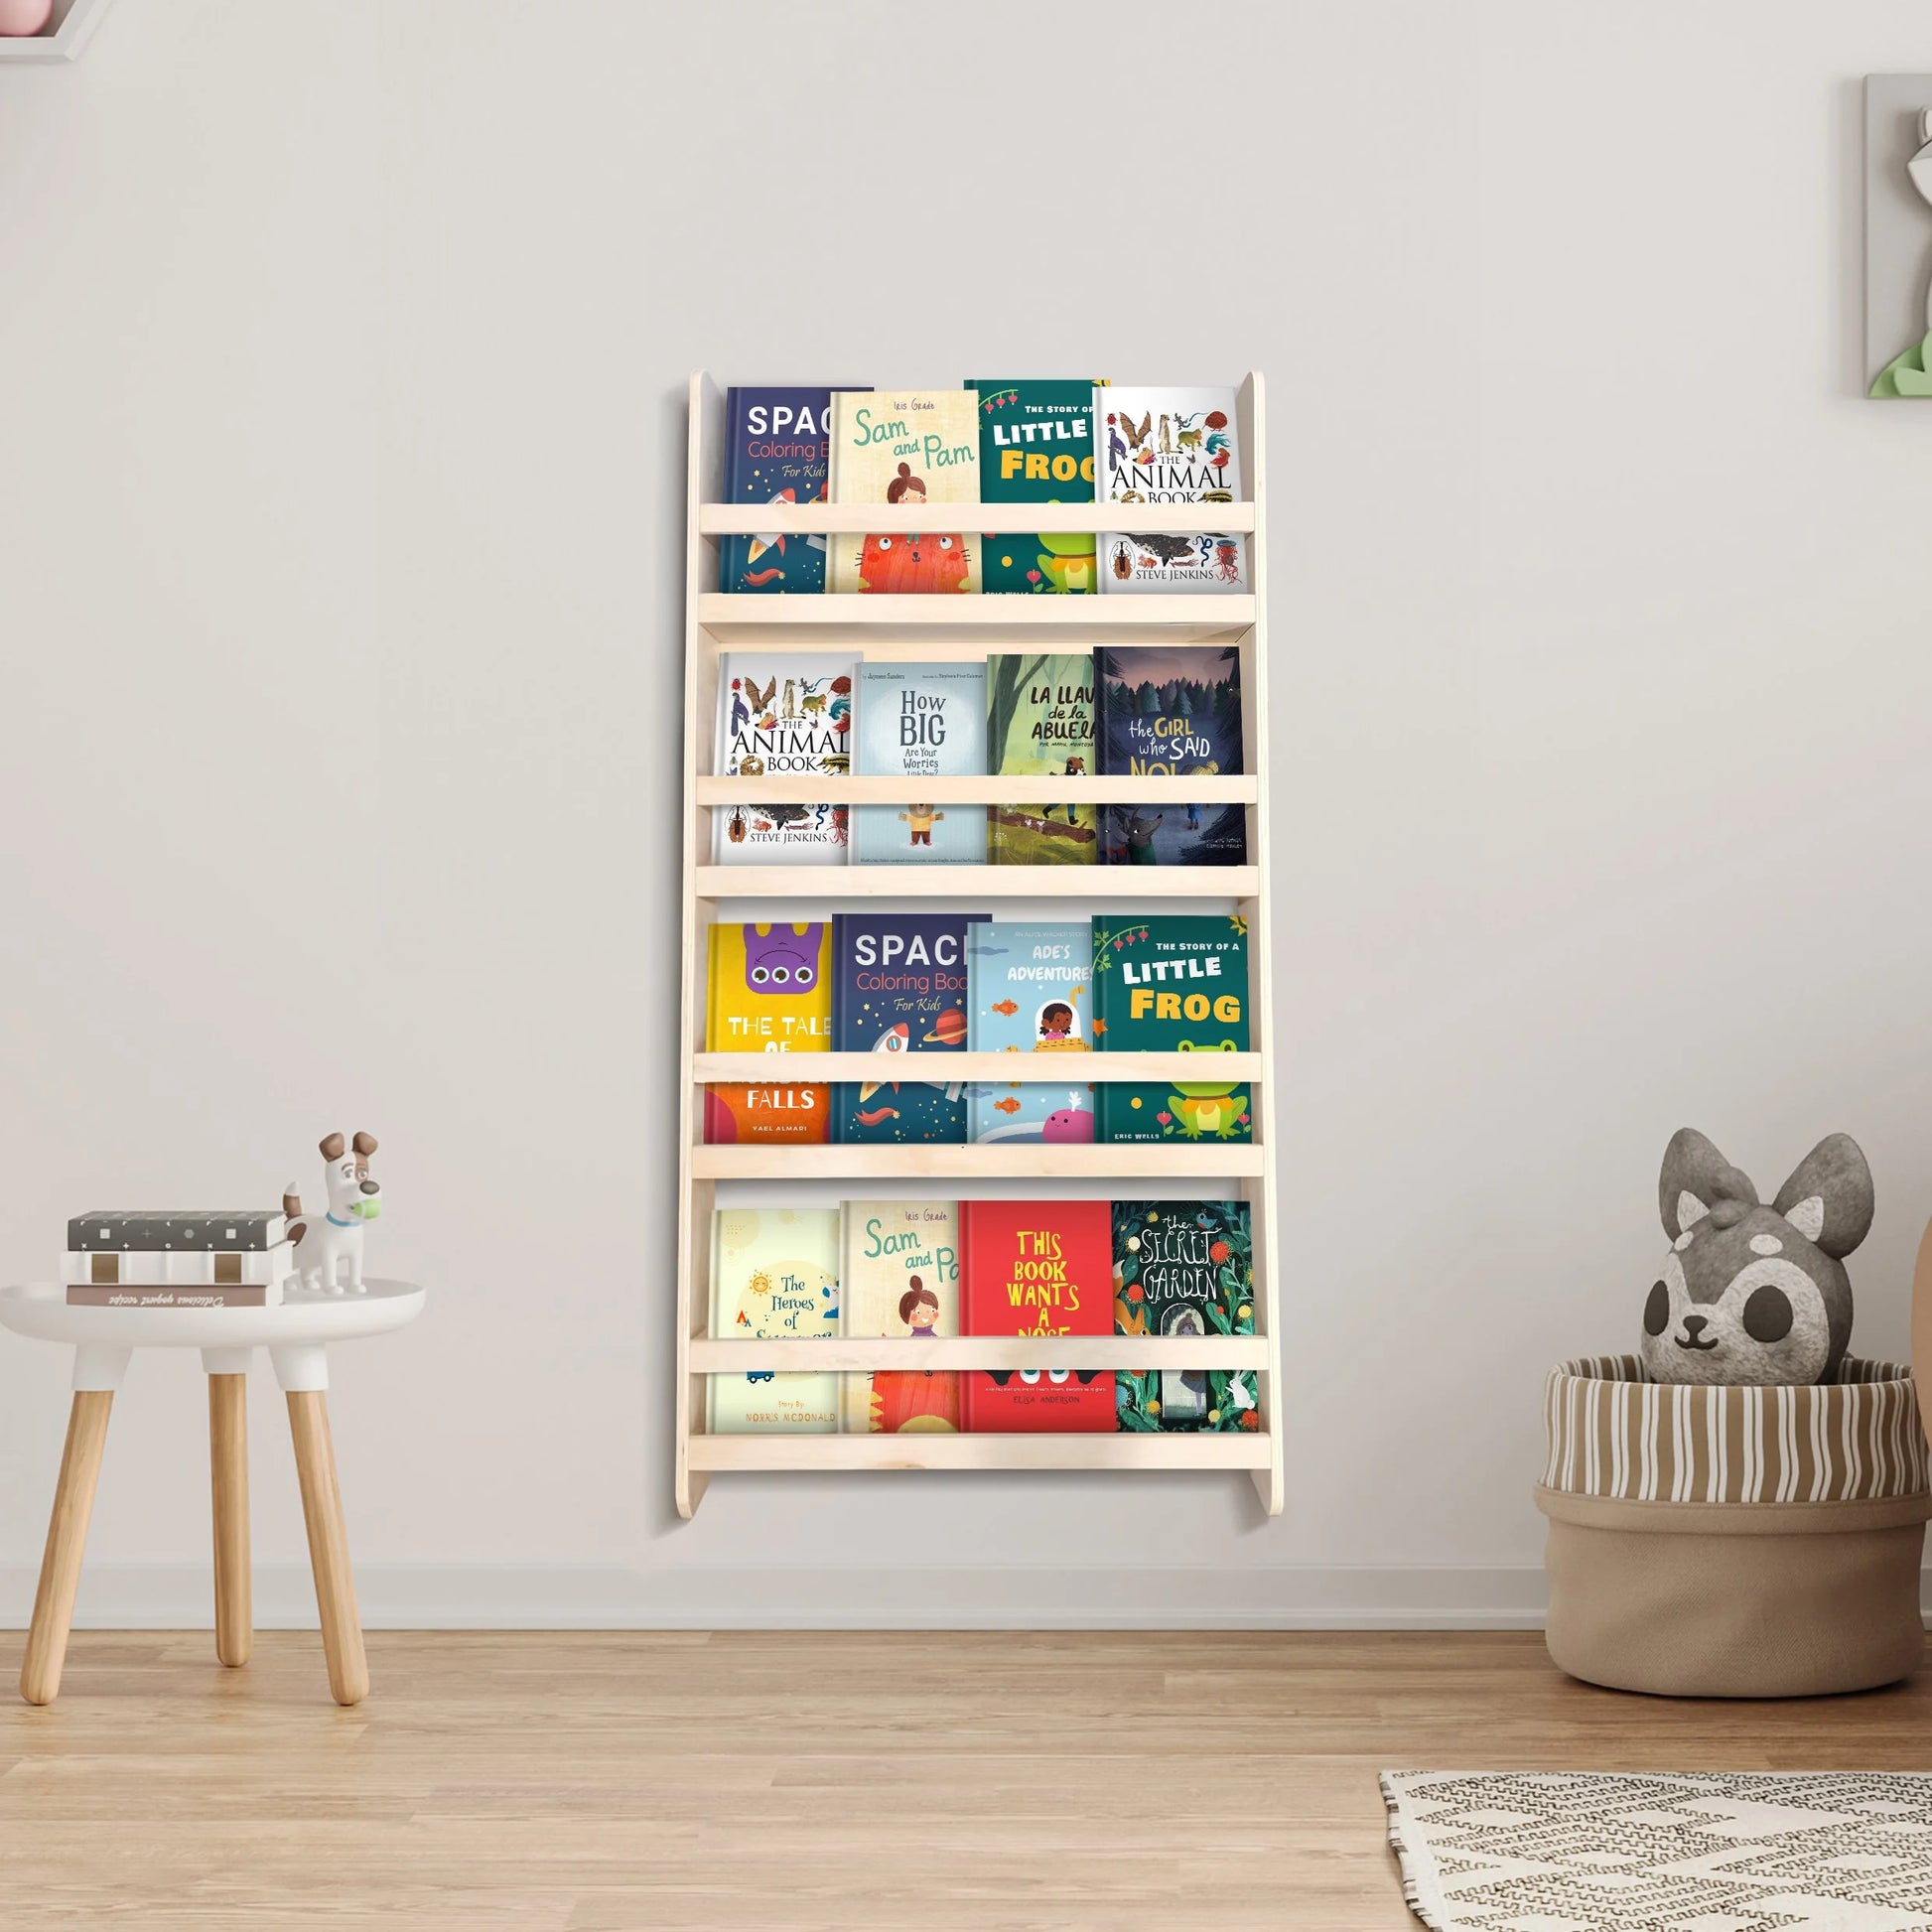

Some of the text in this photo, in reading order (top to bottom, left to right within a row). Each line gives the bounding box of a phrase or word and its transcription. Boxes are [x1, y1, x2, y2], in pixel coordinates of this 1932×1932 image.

[894, 398, 935, 411] Iris Grade
[853, 408, 909, 447] Sam
[993, 419, 1087, 446] LITTLE
[748, 441, 816, 462] Coloring
[894, 439, 921, 457] and
[923, 435, 975, 470] Pam
[1160, 456, 1180, 465] THE
[781, 463, 827, 478] For Kids
[1111, 466, 1232, 489] ANIMAL
[1136, 570, 1214, 582] STEVE JENKINS
[901, 690, 946, 714] How
[1031, 686, 1049, 704] LA
[1047, 705, 1087, 719] de la
[782, 721, 803, 730] THE
[899, 713, 946, 747] BIG
[1128, 717, 1194, 738] the GIRL
[731, 730, 850, 755] ANIMAL
[1139, 737, 1210, 760] who SAID
[904, 748, 937, 758] Are Your
[767, 757, 818, 771] BOOK
[903, 759, 939, 768] Worries
[750, 833, 827, 844] STEVE JENKINS
[855, 935, 968, 966] SPAC
[1033, 945, 1070, 960] ADE'S
[1123, 957, 1222, 985] LITTLE
[856, 972, 929, 995] Coloring
[894, 996, 941, 1012] For Kids
[1130, 989, 1241, 1023] FROG
[728, 1017, 832, 1035] THE TALE
[747, 1090, 815, 1109] FALLS
[905, 1208, 948, 1221] Iris Grade
[1162, 1214, 1193, 1229] the
[864, 1218, 921, 1258] Sam
[1017, 1231, 1062, 1261] THIS
[1139, 1227, 1222, 1267] SECRET
[904, 1252, 933, 1270] and
[1014, 1261, 1067, 1282] BOOK
[781, 1275, 805, 1293] The
[1144, 1264, 1217, 1304] GARDEN
[771, 1295, 815, 1311] Heroes
[1007, 1283, 1080, 1311] WANTS
[784, 1311, 799, 1329] of
[1038, 1308, 1050, 1326] A
